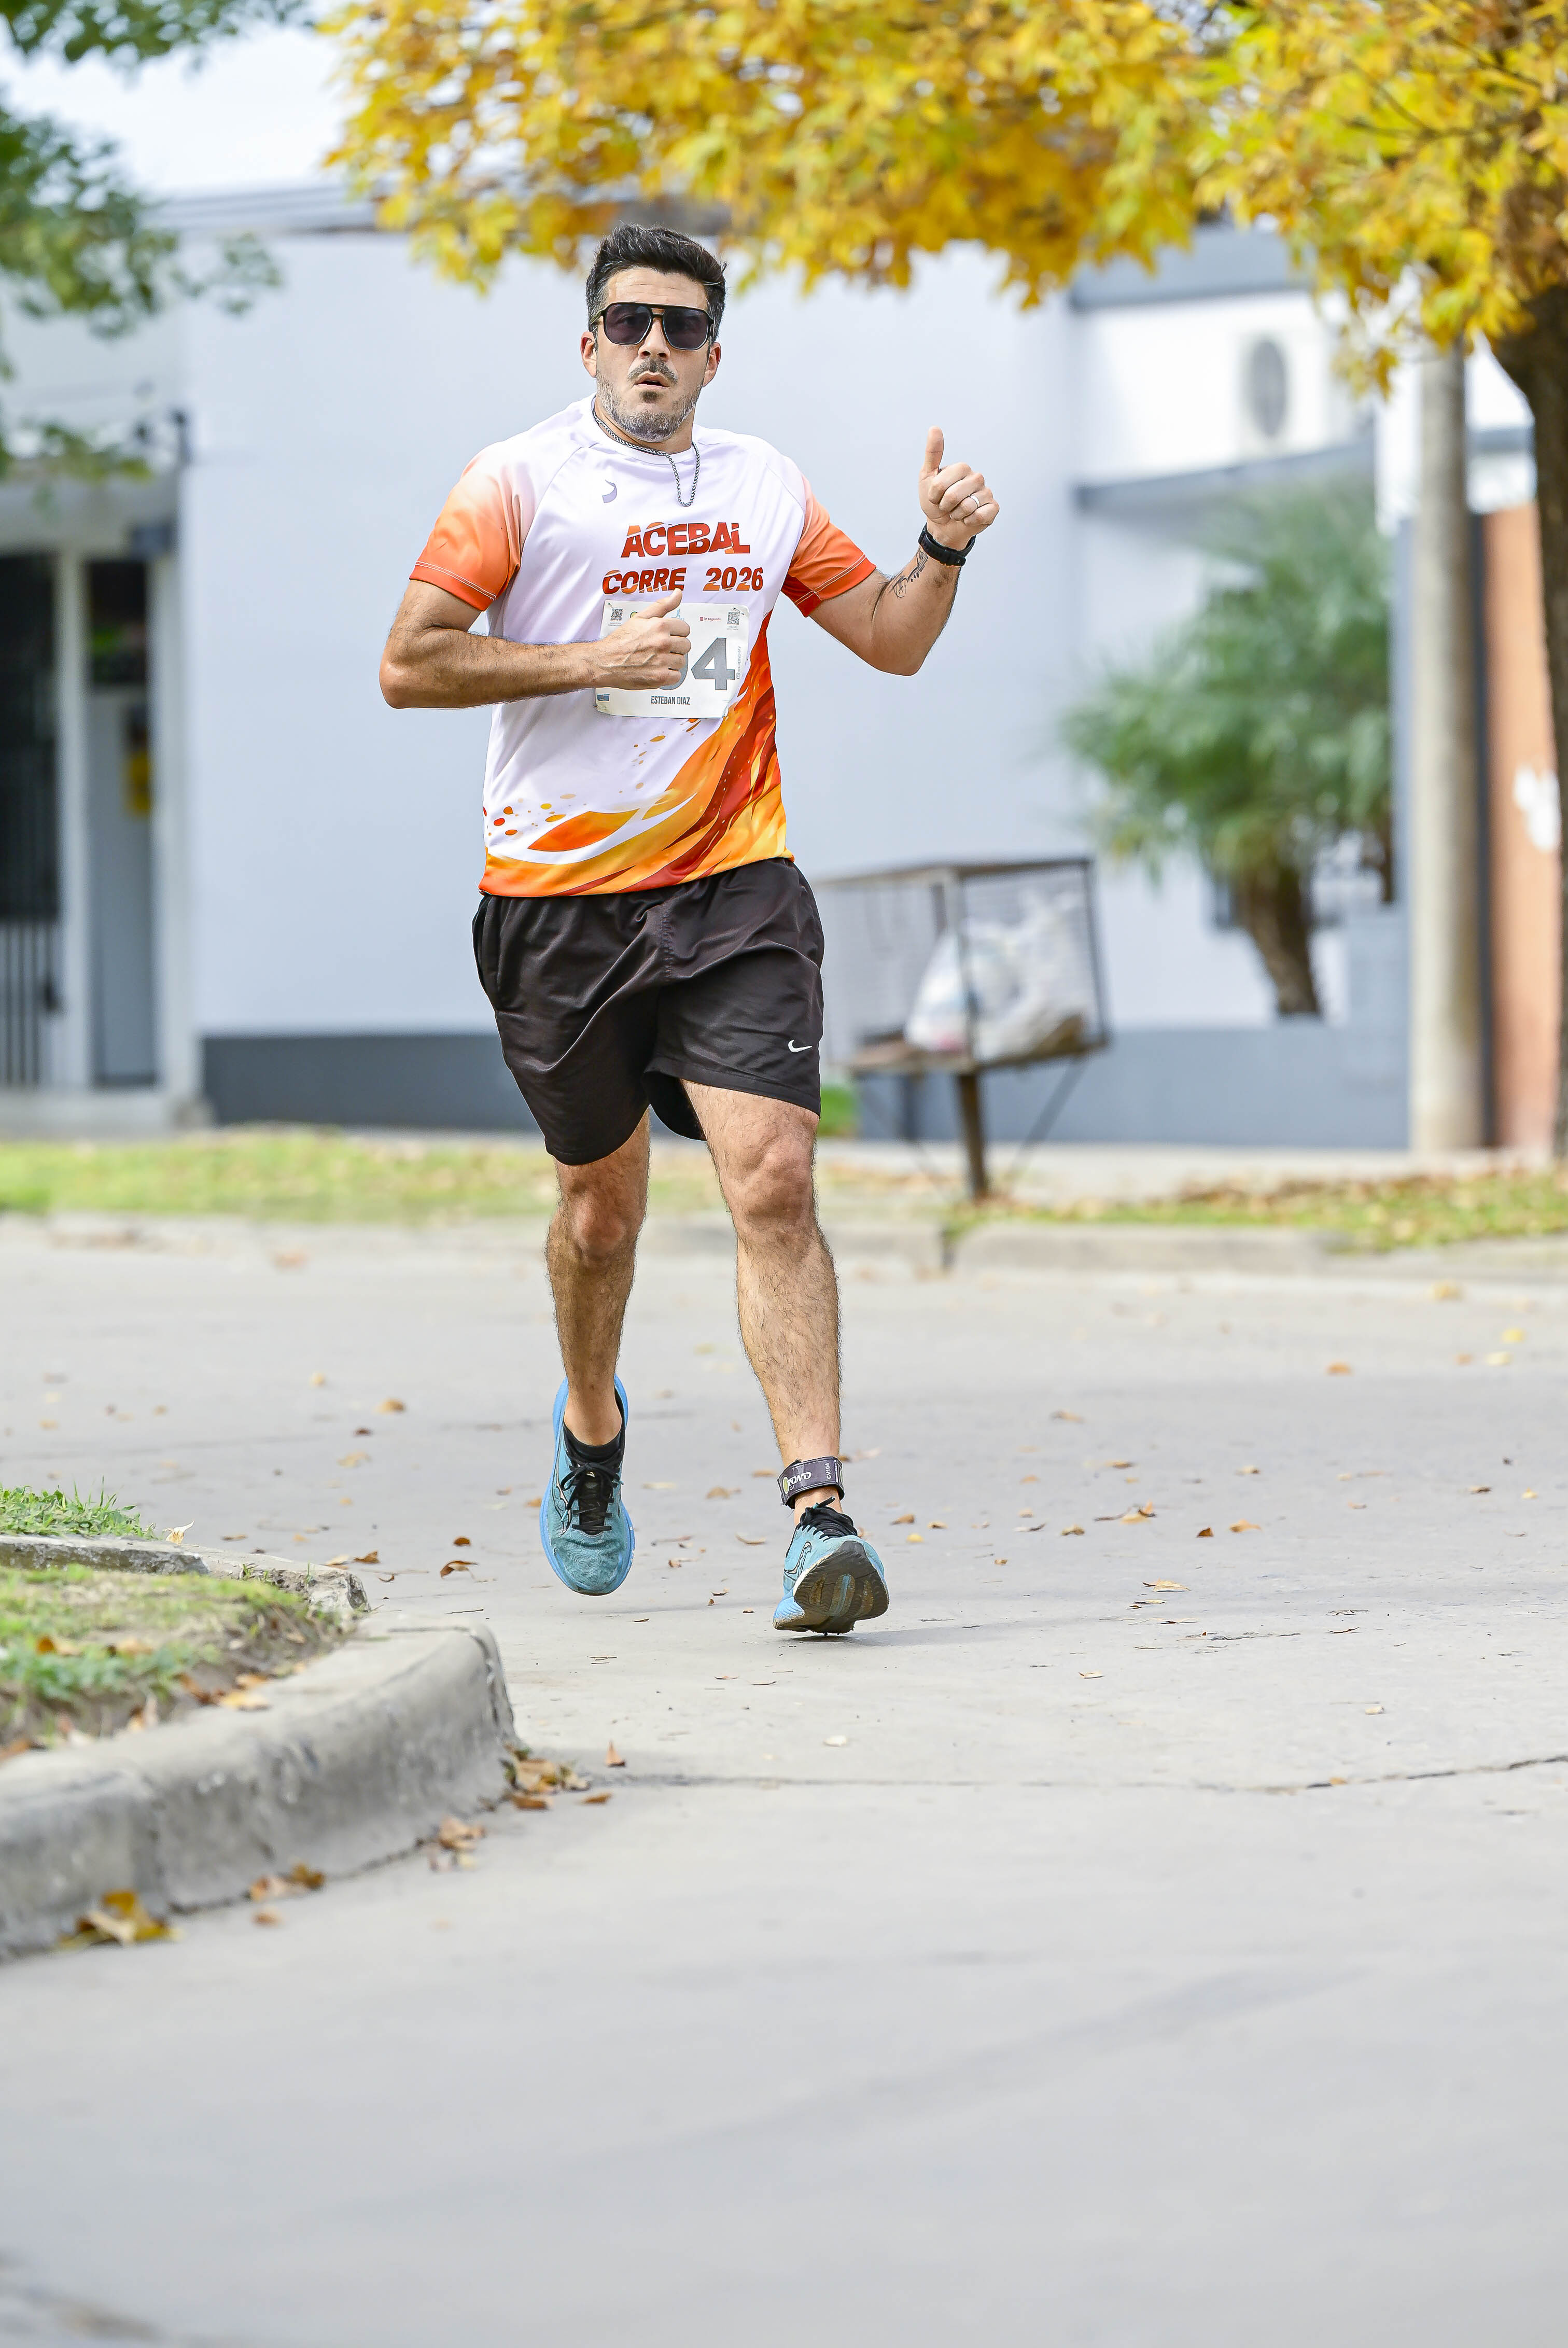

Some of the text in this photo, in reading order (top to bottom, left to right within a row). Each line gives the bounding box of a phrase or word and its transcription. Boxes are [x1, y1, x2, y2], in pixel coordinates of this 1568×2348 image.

[621, 522, 750, 558] ACEBAL
[603, 567, 764, 595] CORRE 2026
[651, 696, 691, 705] ESTEBAN DIAZ
